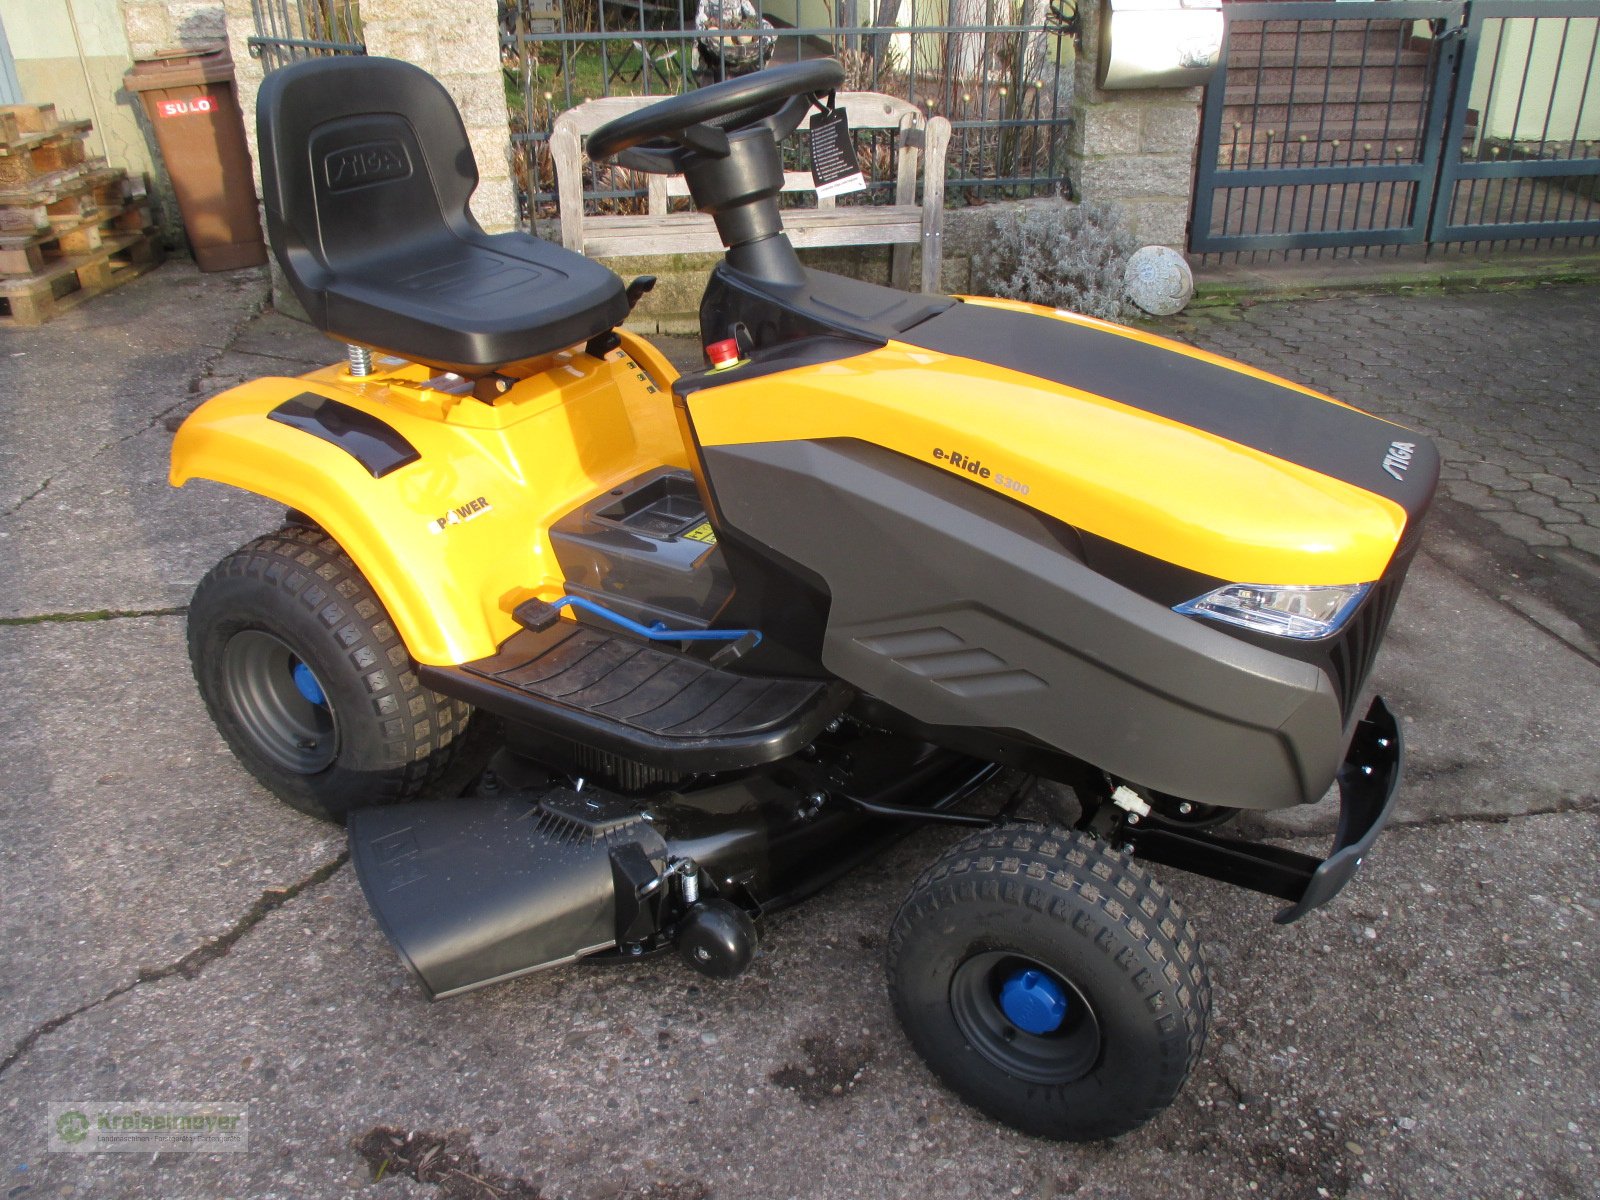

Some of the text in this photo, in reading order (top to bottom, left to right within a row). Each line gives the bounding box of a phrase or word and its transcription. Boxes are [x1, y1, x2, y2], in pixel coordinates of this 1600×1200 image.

[165, 100, 210, 115] SULO
[933, 447, 1030, 496] e-Ride S300
[1382, 441, 1416, 481] STIGA
